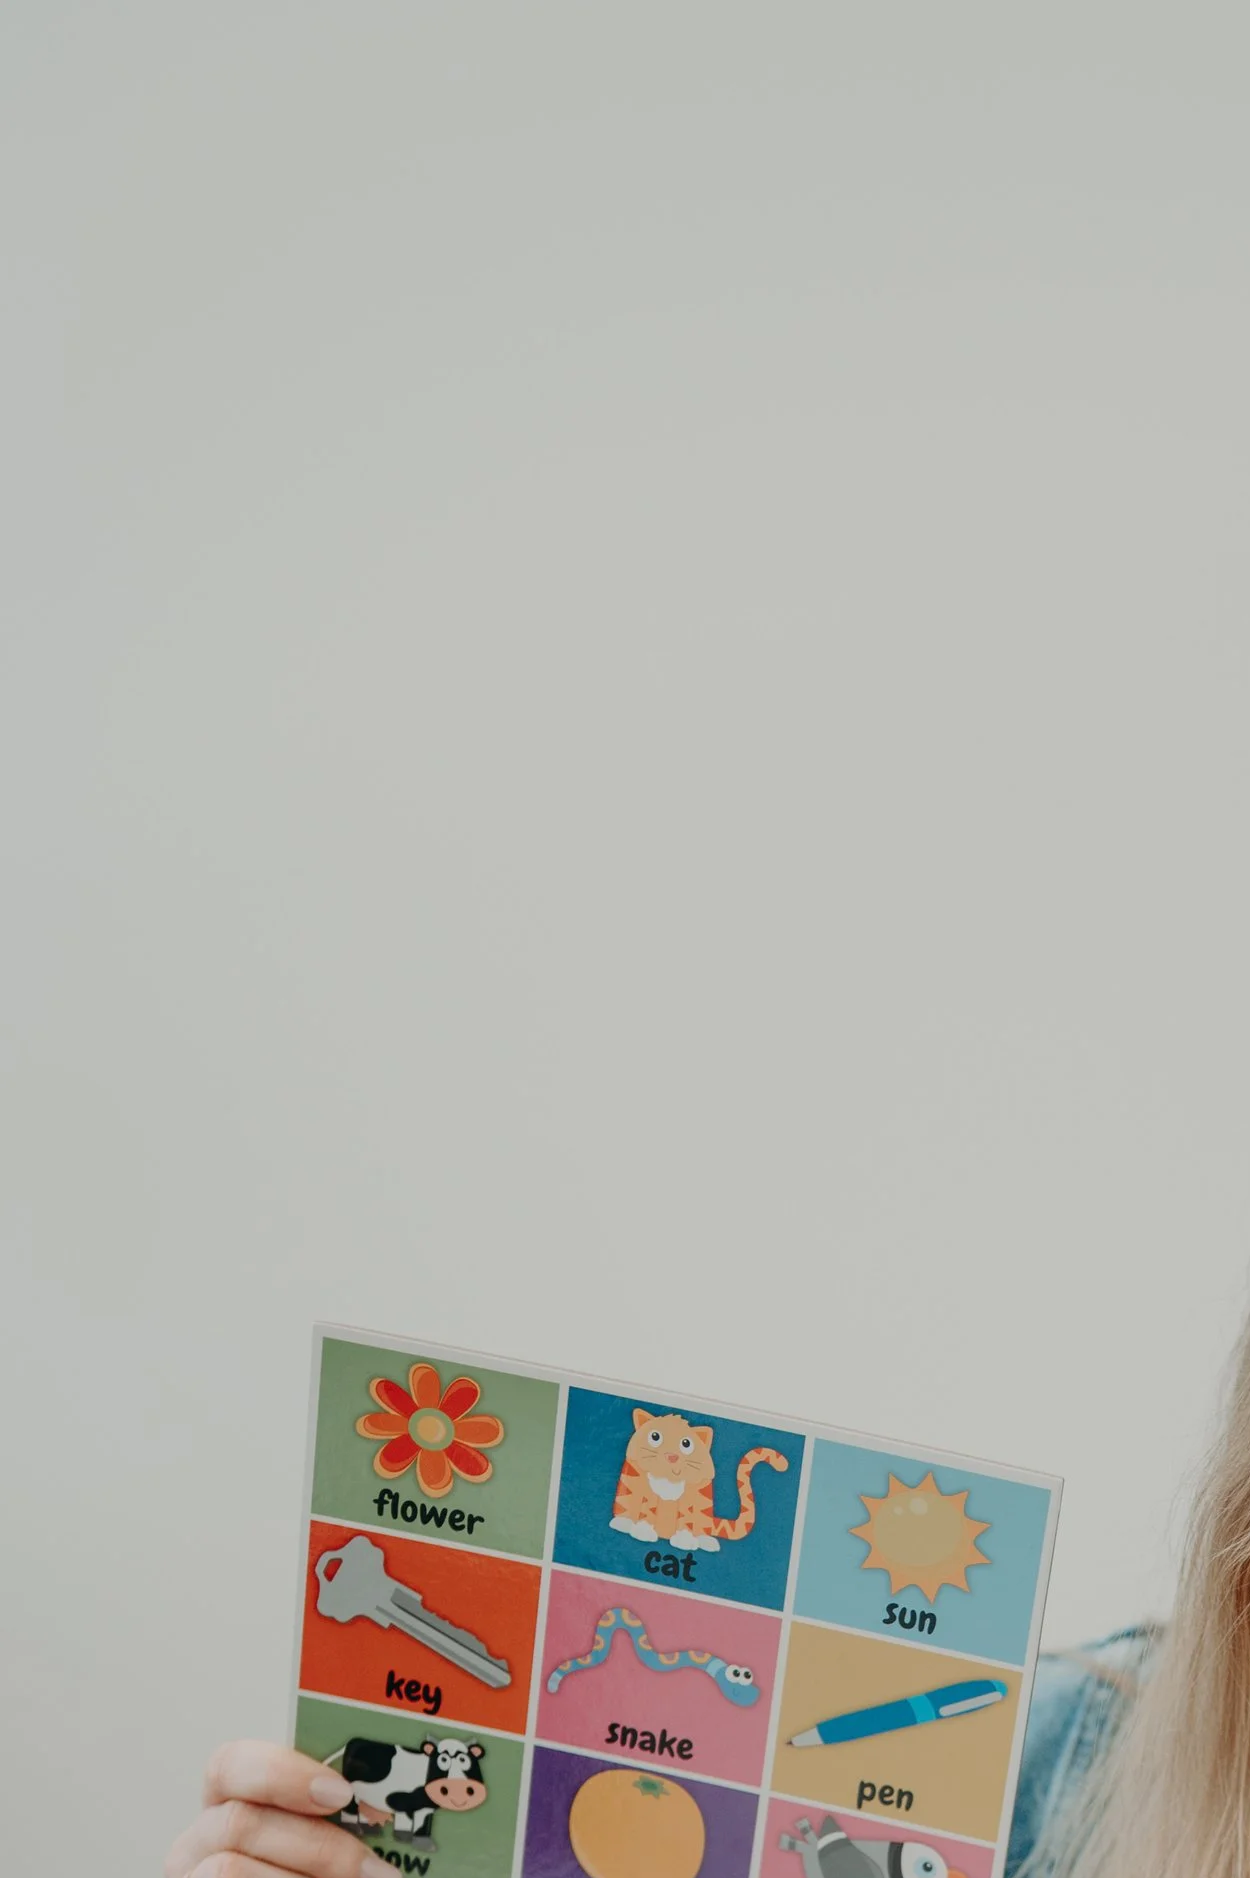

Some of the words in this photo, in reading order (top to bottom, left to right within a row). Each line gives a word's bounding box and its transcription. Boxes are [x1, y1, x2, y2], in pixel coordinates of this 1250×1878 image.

[371, 1487, 485, 1535] flower
[643, 1550, 697, 1583] cat
[882, 1601, 937, 1635] sun
[385, 1669, 443, 1716] key
[605, 1721, 694, 1760] snake
[856, 1779, 914, 1811] pen
